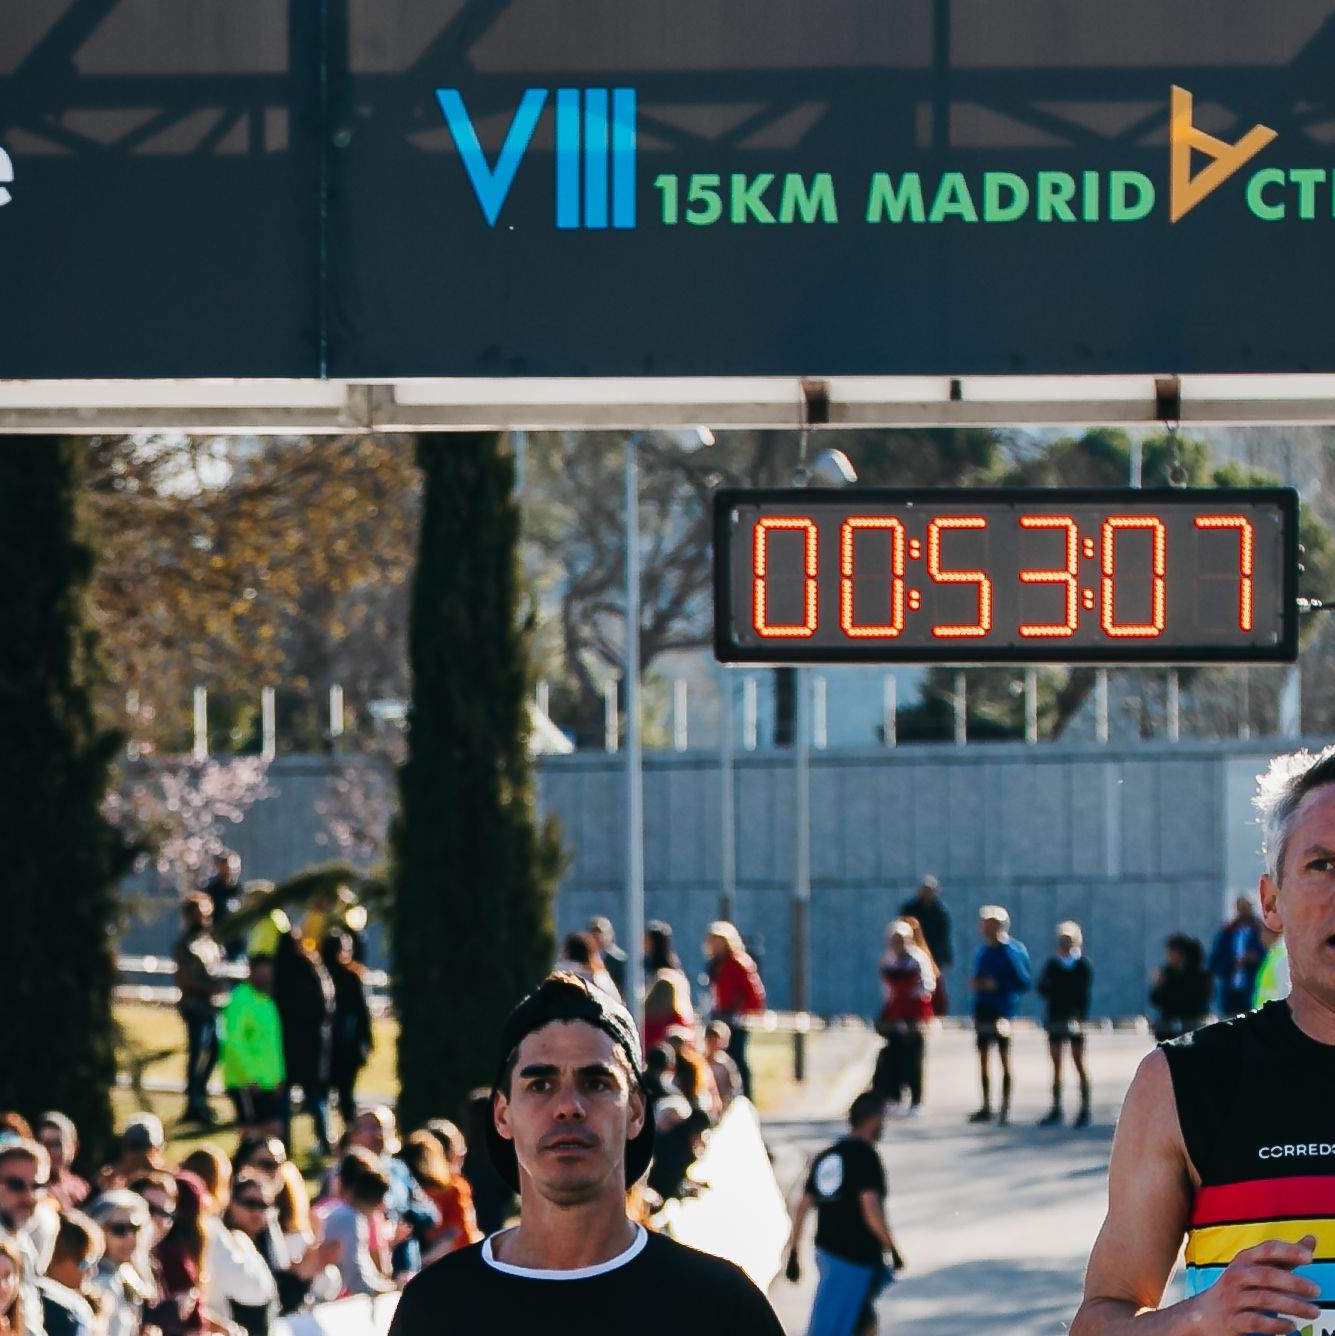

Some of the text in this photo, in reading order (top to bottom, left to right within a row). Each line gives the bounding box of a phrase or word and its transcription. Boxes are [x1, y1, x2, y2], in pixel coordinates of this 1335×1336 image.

[435, 87, 638, 228] VIII
[653, 171, 839, 226] 15KM
[865, 169, 1157, 223] MADRID
